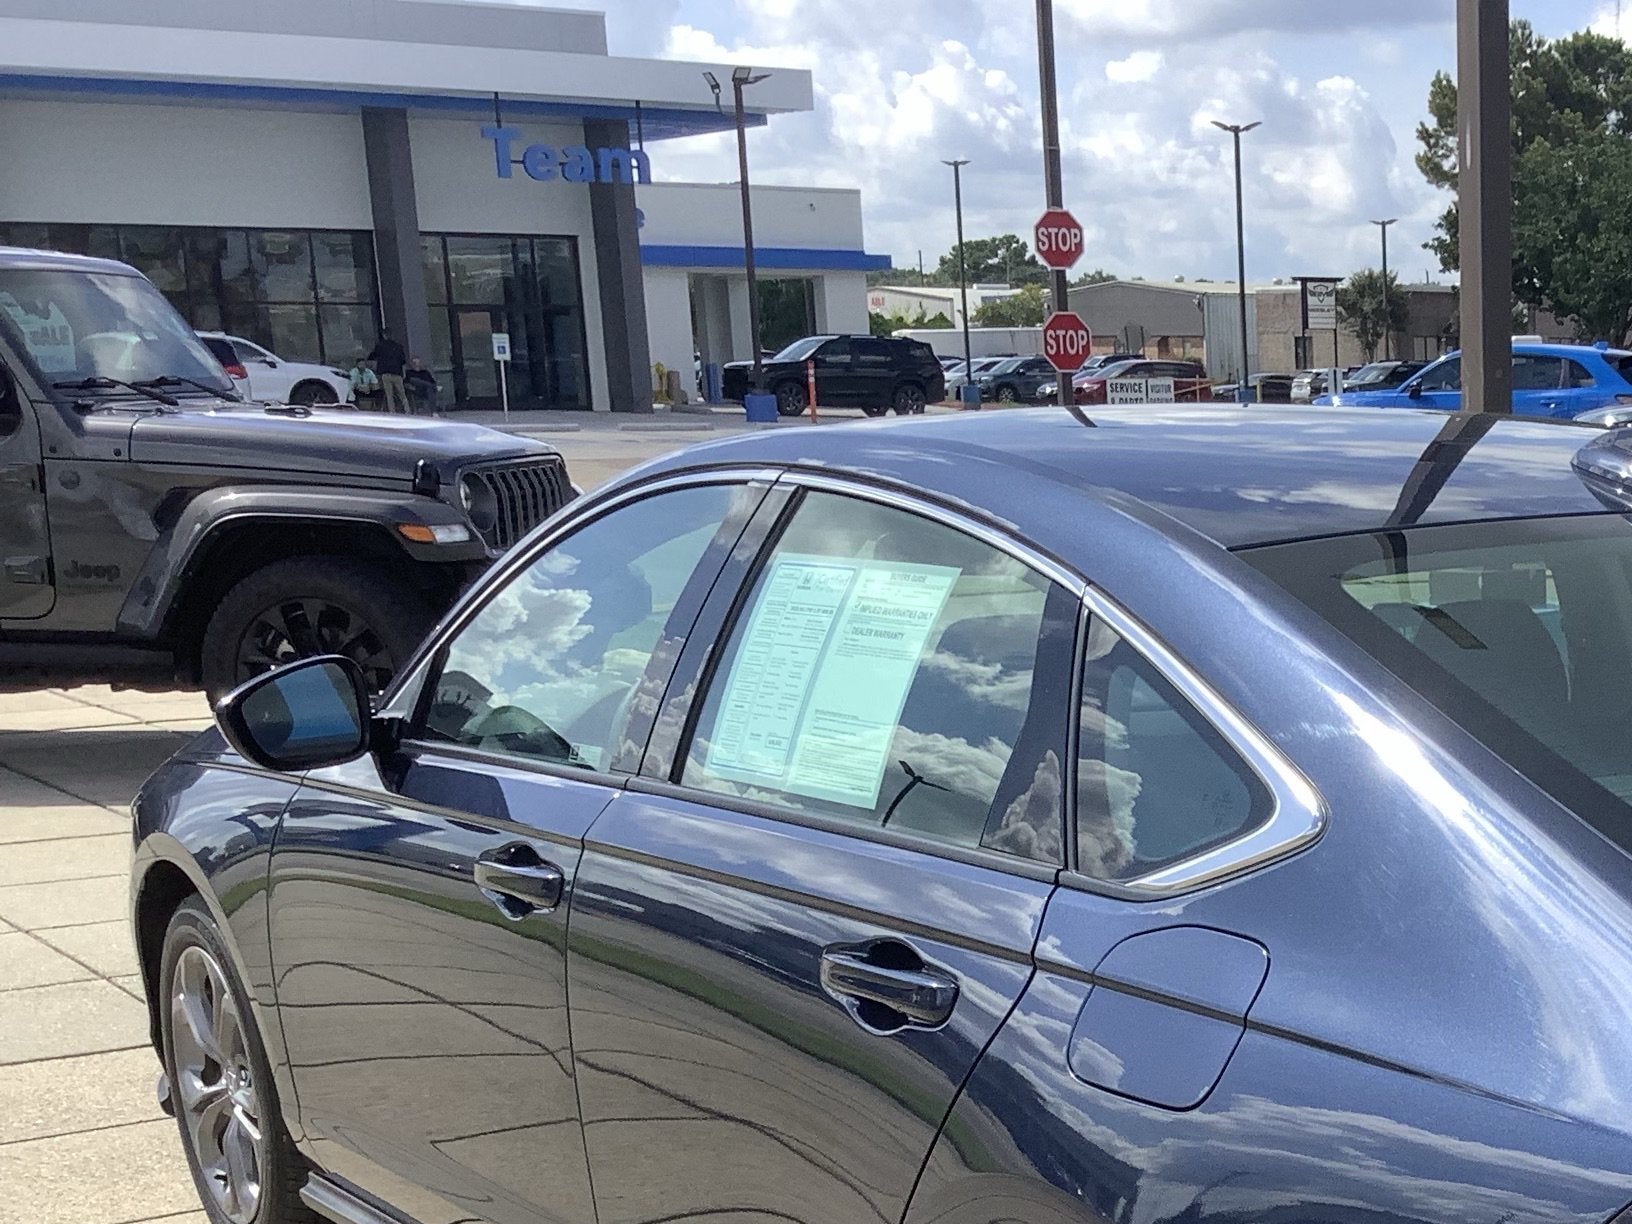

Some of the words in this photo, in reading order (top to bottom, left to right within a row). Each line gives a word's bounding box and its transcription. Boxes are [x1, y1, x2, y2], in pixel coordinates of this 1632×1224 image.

[481, 126, 652, 184] Team
[1037, 227, 1081, 252] STOP
[1046, 329, 1088, 355] STOP
[1109, 382, 1143, 393] SERVICE
[63, 560, 121, 582] Jeep
[851, 626, 873, 638] DEALER
[873, 628, 905, 641] WARRANTY
